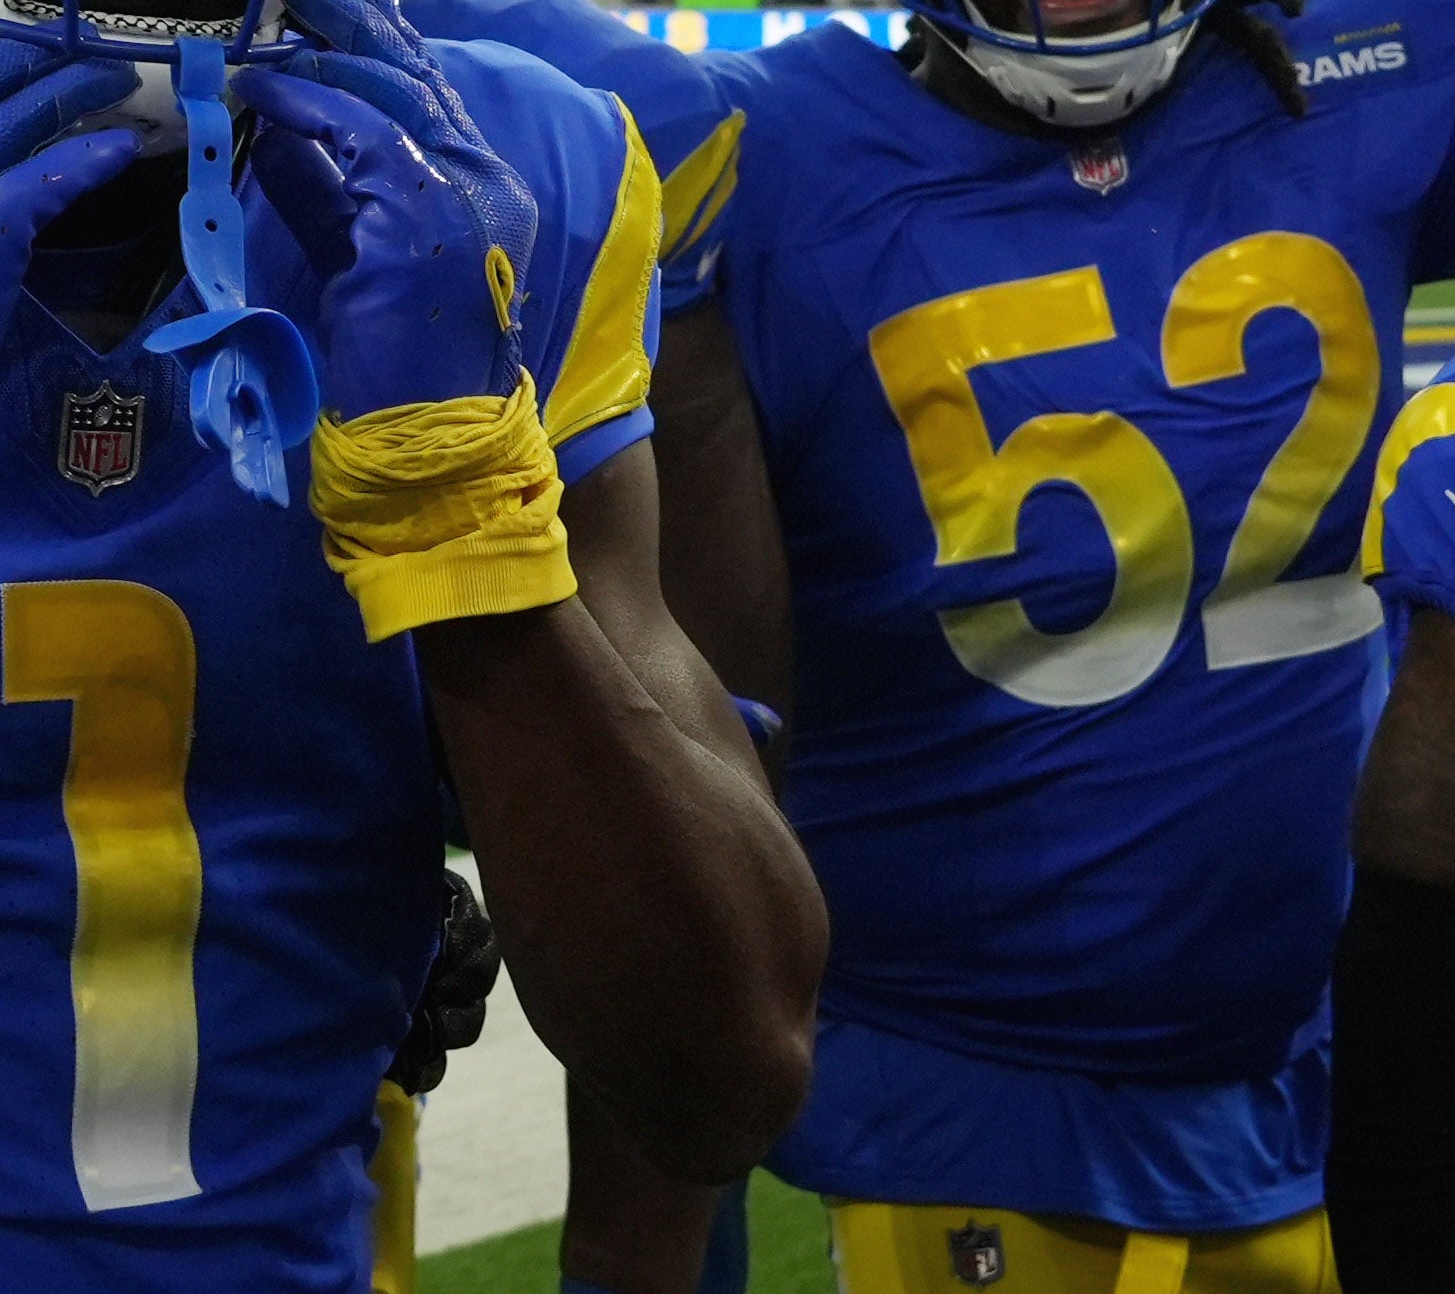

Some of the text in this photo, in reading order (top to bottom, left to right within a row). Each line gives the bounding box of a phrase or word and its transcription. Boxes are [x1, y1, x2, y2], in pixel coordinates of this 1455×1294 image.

[1293, 42, 1408, 86] RAMS
[72, 431, 127, 474] NFL
[869, 230, 1385, 707] 52
[0, 579, 204, 1212] 1
